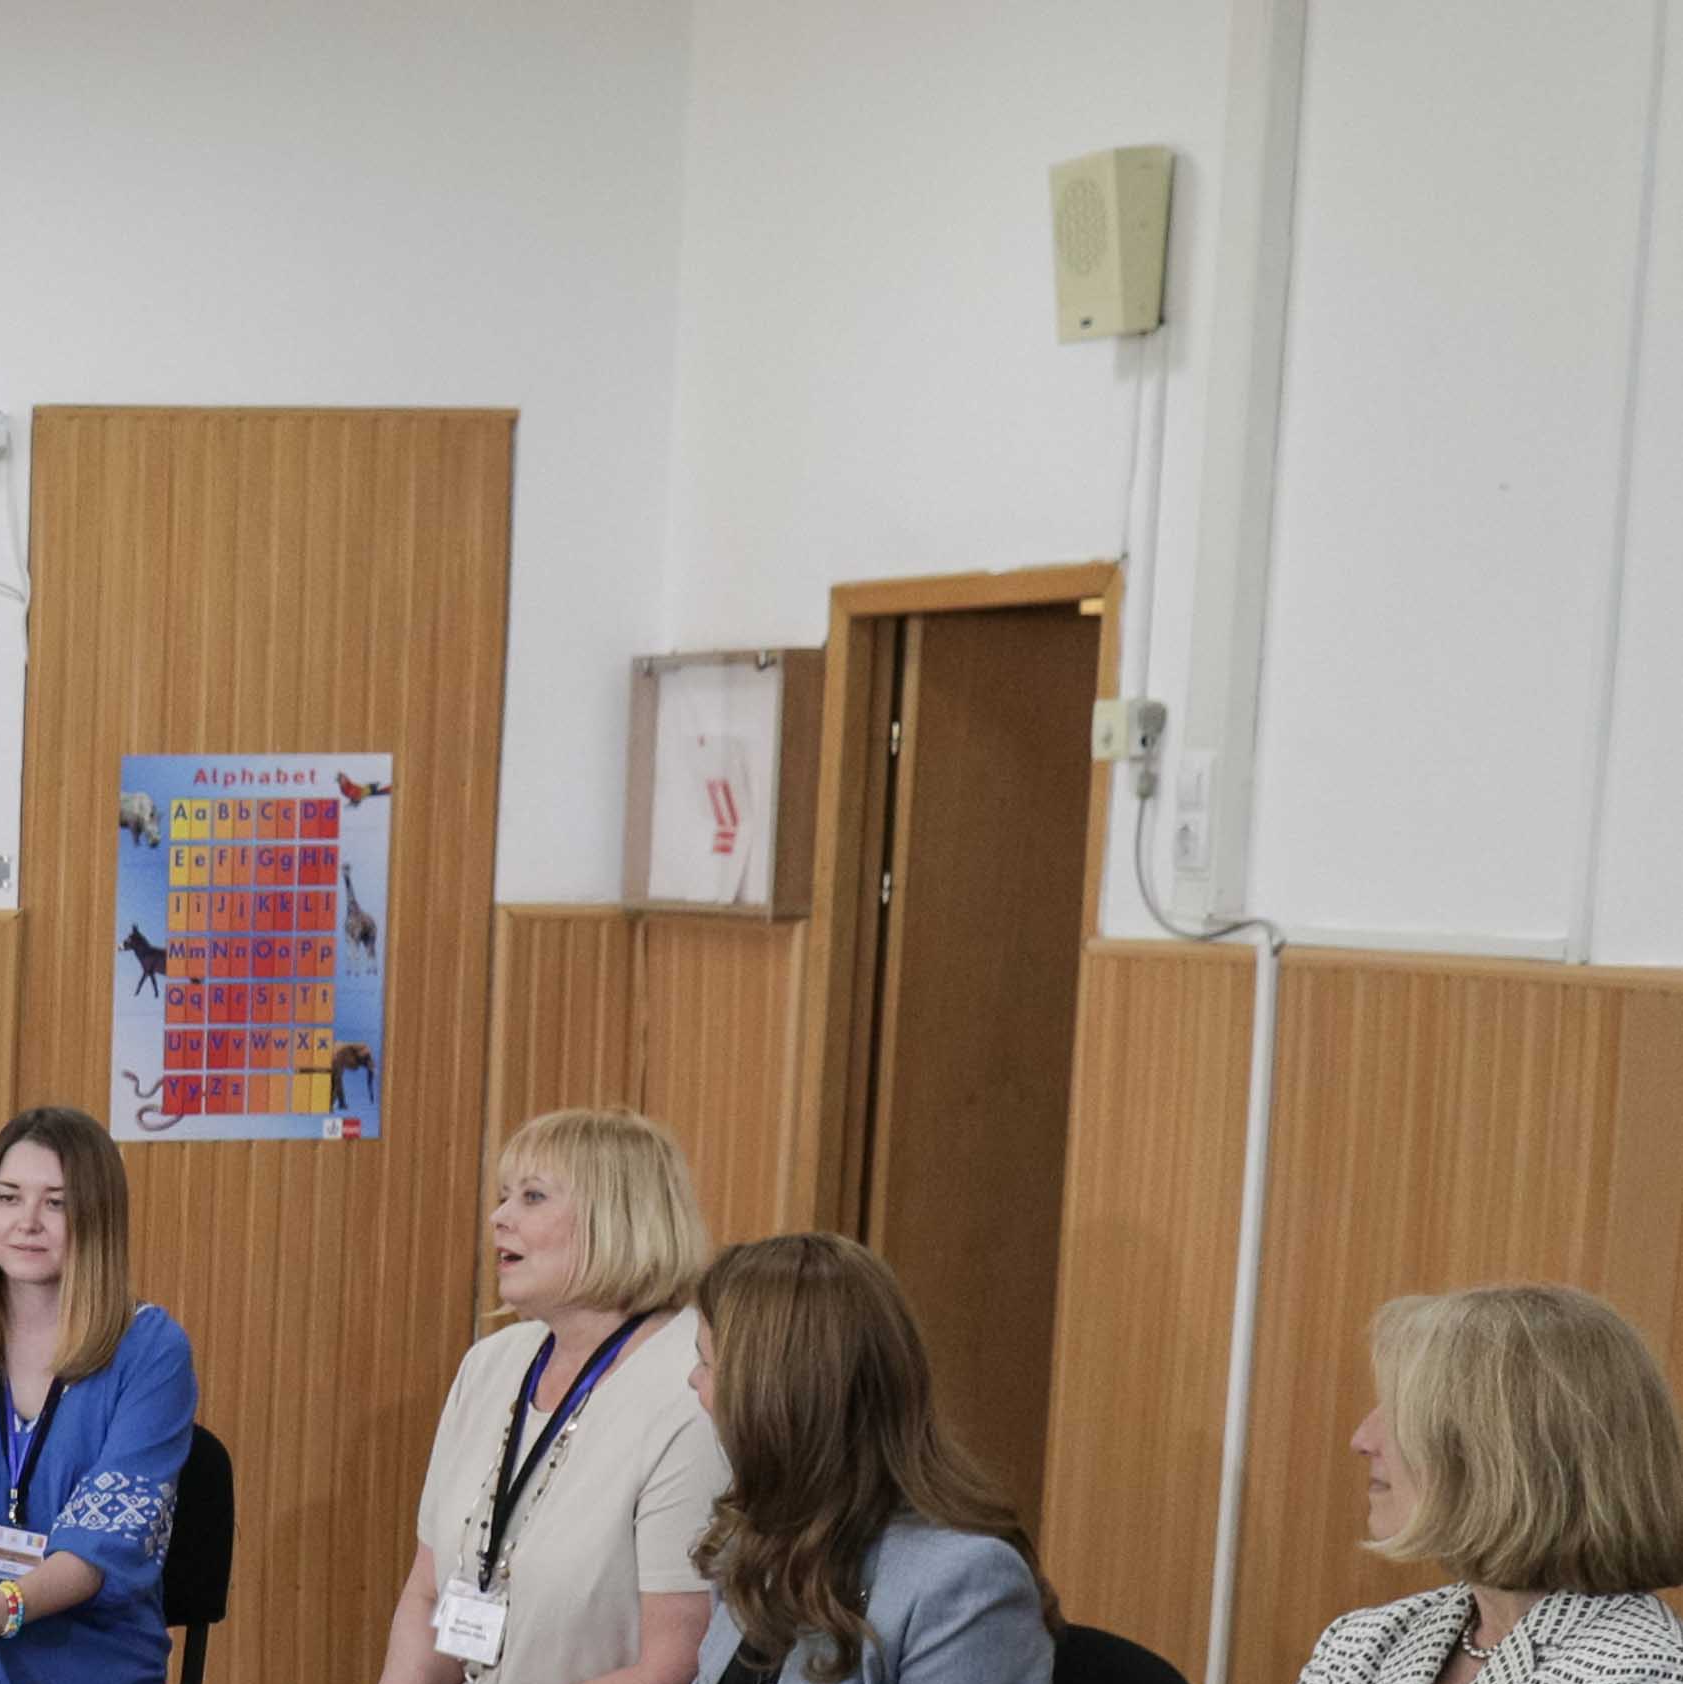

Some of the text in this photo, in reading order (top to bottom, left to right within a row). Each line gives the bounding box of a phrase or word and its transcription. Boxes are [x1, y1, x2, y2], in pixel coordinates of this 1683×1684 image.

[193, 768, 316, 787] Alphabet
[174, 803, 188, 820] A
[195, 809, 206, 820] a
[219, 803, 229, 820] B
[239, 802, 250, 820] b
[261, 802, 273, 820] C
[304, 802, 317, 819] D
[175, 850, 184, 866] E
[195, 855, 205, 866] e
[219, 851, 227, 866] F
[259, 850, 273, 867] G
[281, 855, 292, 872] g
[303, 850, 316, 865] H
[218, 896, 225, 912] J
[260, 896, 269, 912] K
[304, 895, 311, 912] L
[169, 941, 331, 962] M m N n O o P p
[169, 988, 184, 1006] Q
[214, 988, 224, 1004] R
[257, 988, 267, 1005] S
[301, 987, 310, 1003] T
[169, 1033, 181, 1050] U
[190, 1039, 200, 1050] u
[212, 1034, 223, 1049] V
[233, 1039, 243, 1049] v
[253, 1033, 269, 1049] W
[274, 1039, 287, 1048] w
[298, 1033, 309, 1049] X
[170, 1080, 179, 1095] Y
